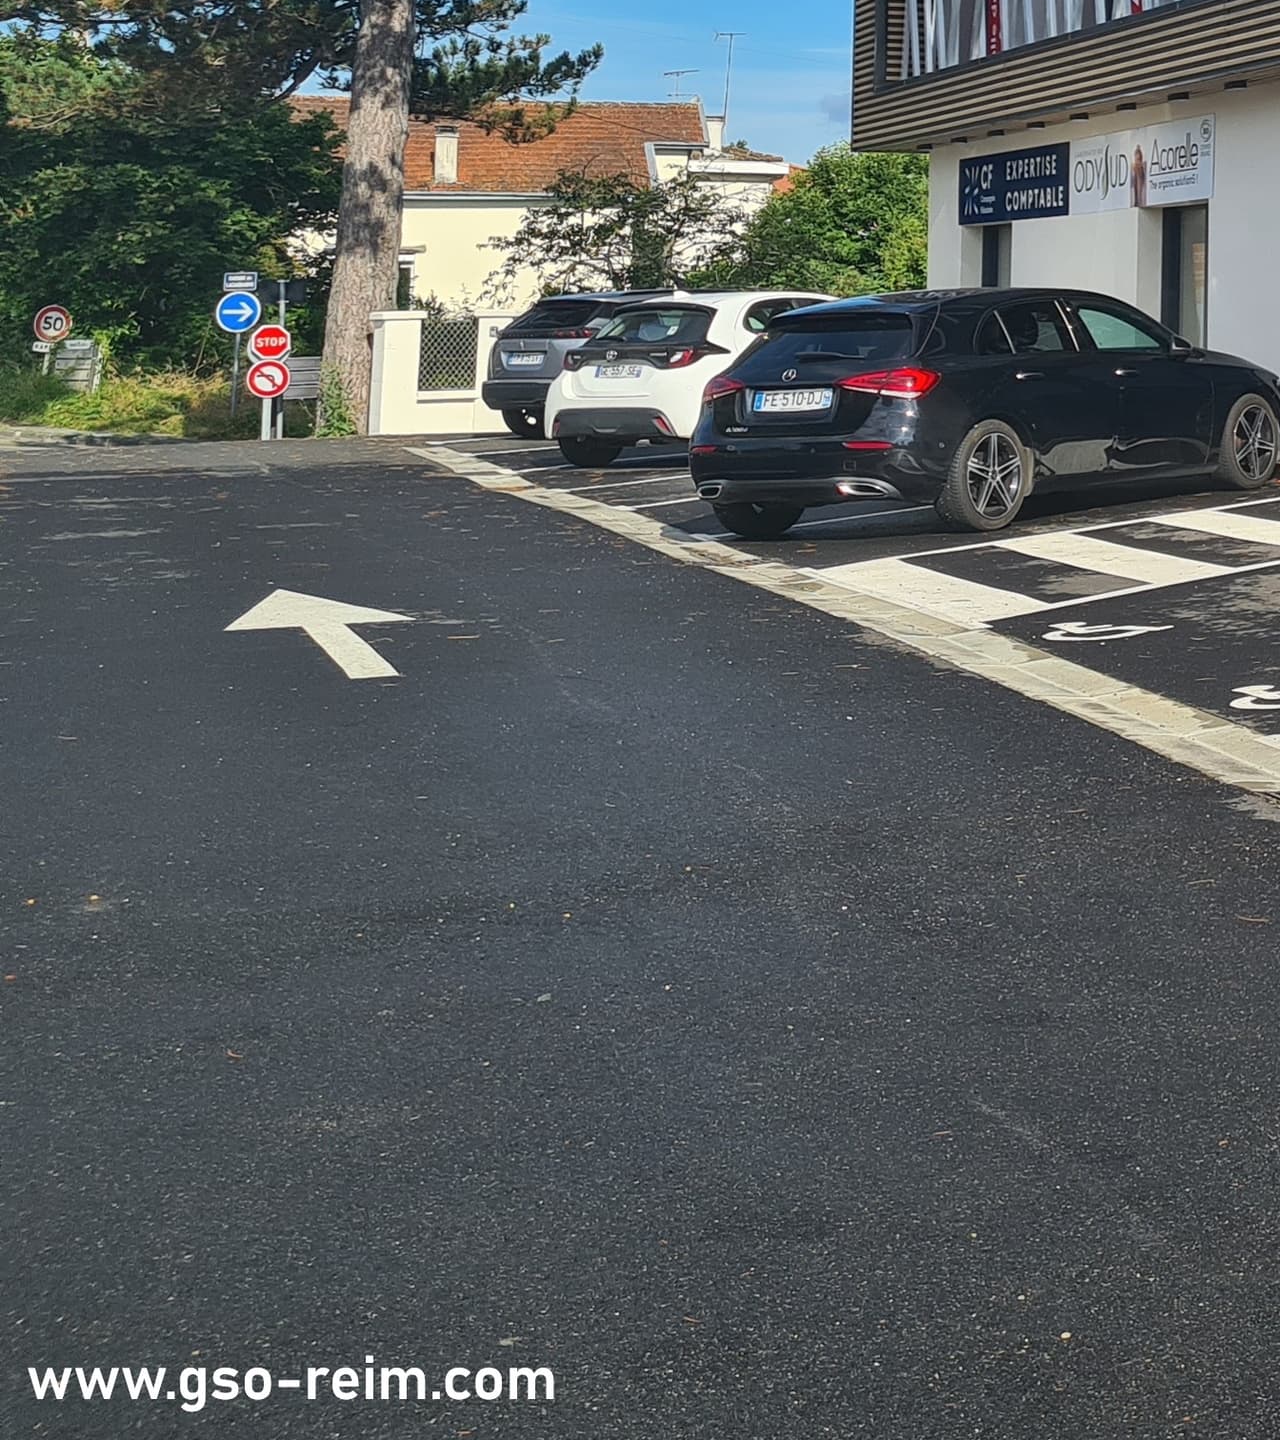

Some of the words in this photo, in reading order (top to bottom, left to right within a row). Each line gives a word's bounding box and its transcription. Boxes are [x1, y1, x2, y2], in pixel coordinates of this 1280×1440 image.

[1006, 154, 1056, 180] EXPERTISE
[1150, 132, 1199, 176] Acorelle
[981, 164, 993, 190] CF
[1074, 144, 1129, 200] ODYSUD
[1005, 185, 1064, 211] COMPTABLE
[43, 316, 63, 331] 50
[256, 337, 286, 347] STOP
